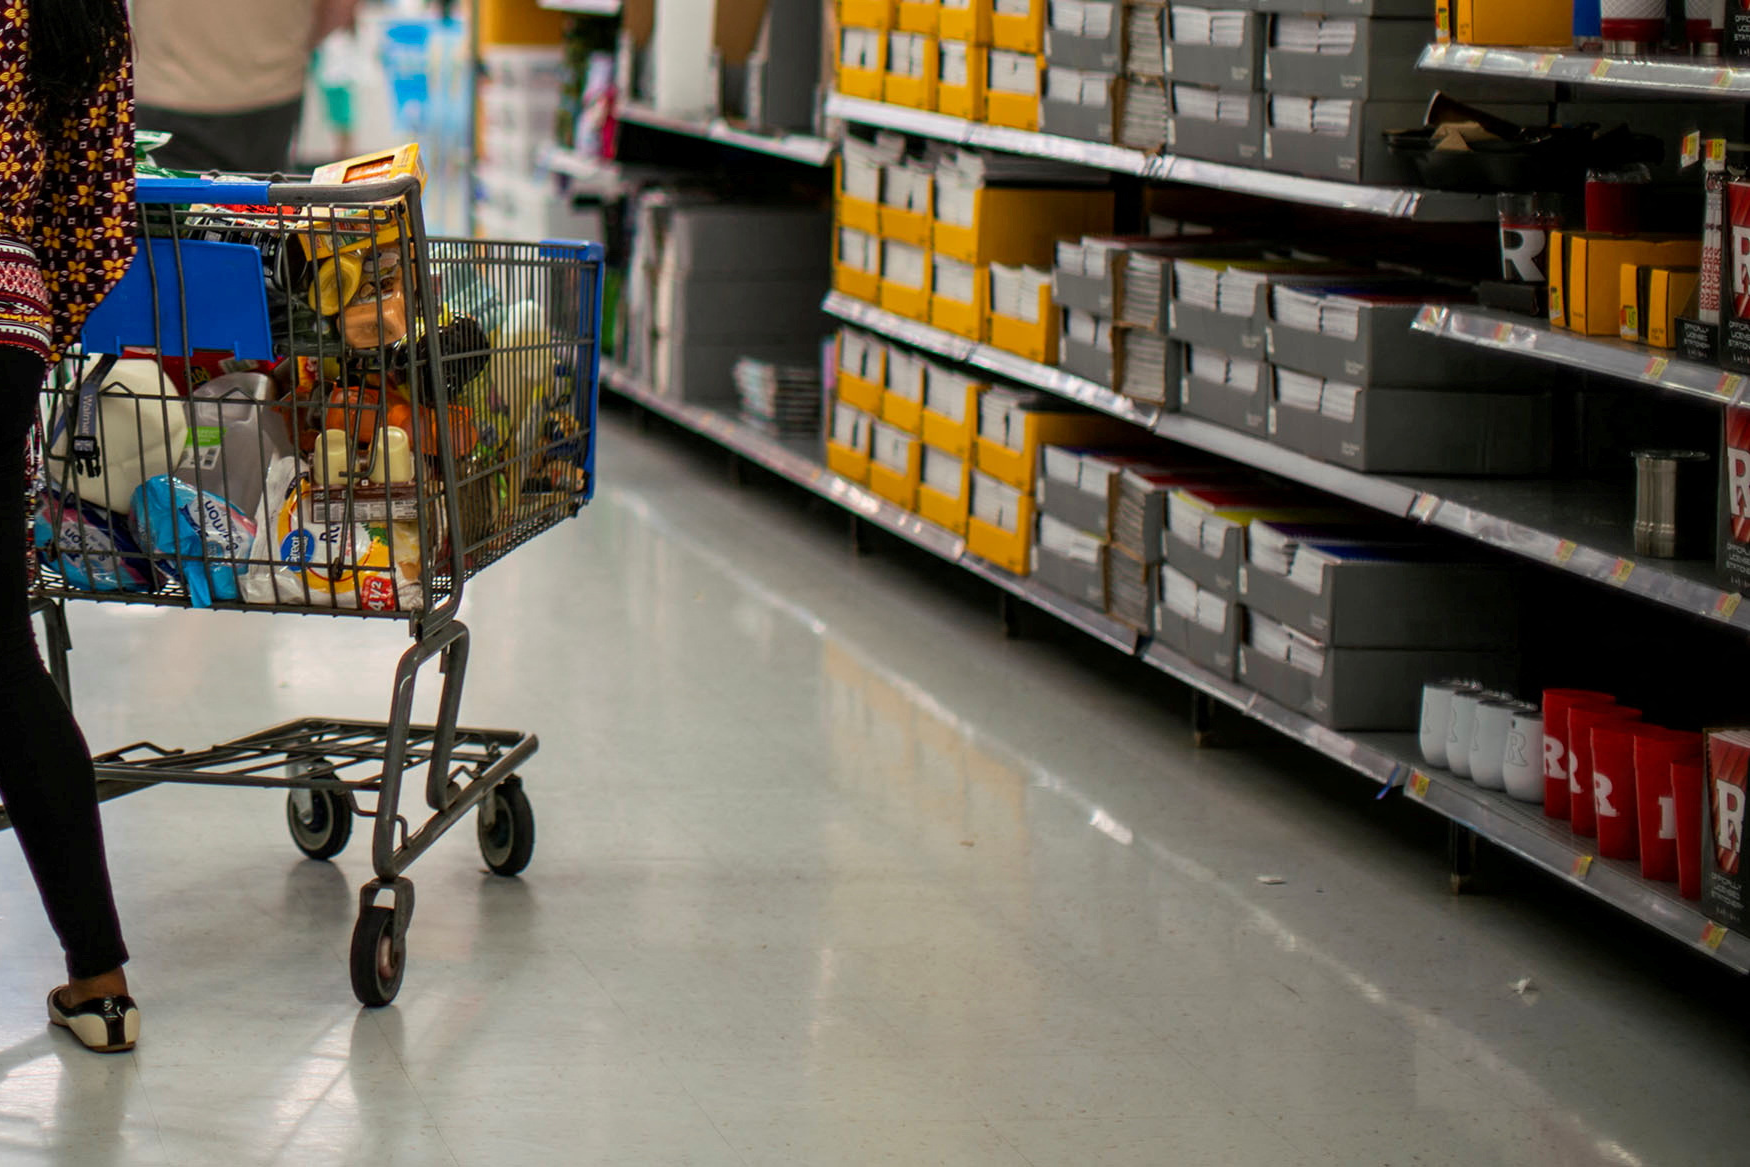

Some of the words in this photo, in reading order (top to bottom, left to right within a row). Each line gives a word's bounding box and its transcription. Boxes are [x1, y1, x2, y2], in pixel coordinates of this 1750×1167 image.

[1502, 228, 1547, 281] R
[82, 394, 93, 434] Walmar
[1716, 778, 1746, 853] R
